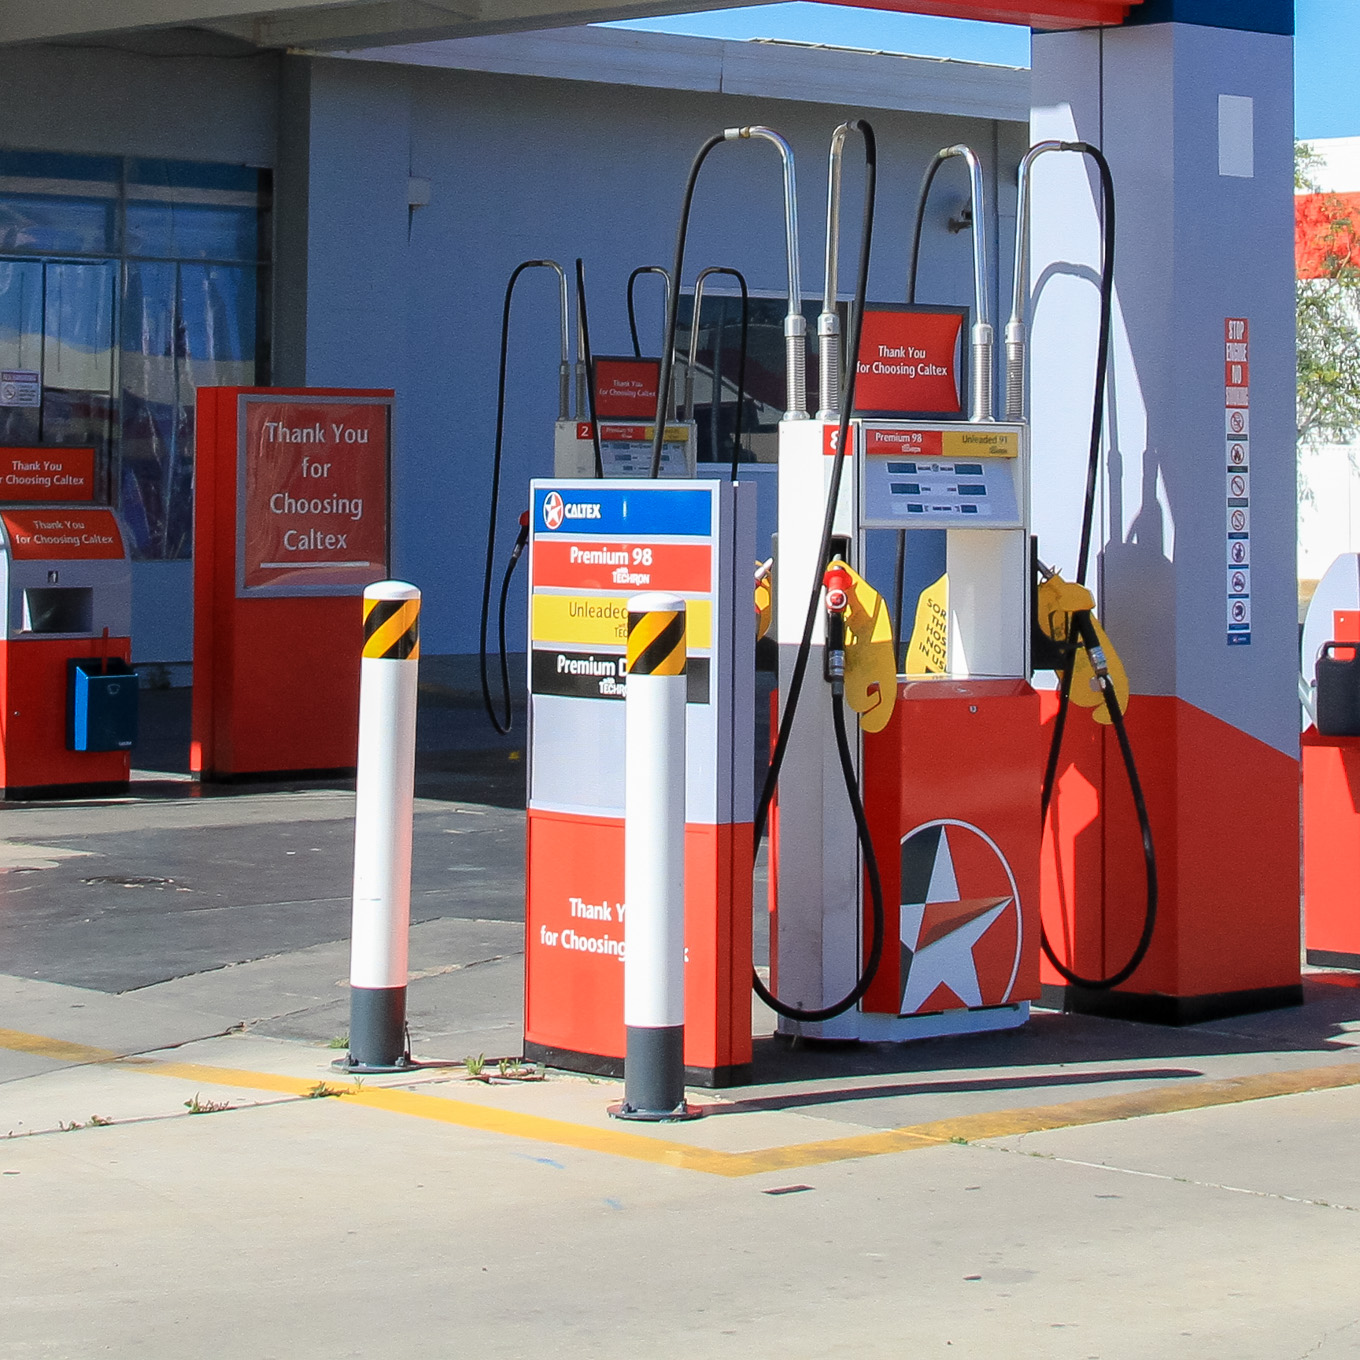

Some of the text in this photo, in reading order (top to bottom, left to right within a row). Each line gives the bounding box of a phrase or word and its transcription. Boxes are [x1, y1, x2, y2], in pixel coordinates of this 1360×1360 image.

[1228, 320, 1244, 340] STOP
[878, 345, 926, 359] Thank You
[856, 362, 947, 378] for Choosing Caltex
[266, 422, 368, 444] Thank You
[580, 425, 589, 437] 2
[875, 432, 922, 443] Premium 98
[962, 435, 997, 445] Unleaded
[11, 460, 62, 471] Thank You
[301, 457, 331, 478] for
[5, 474, 51, 487] Choosing
[53, 475, 84, 485] Caltex
[269, 492, 363, 521] Choosing
[564, 503, 601, 519] CALTEX
[33, 520, 85, 529] Thank You
[15, 534, 113, 546] for Choosing Caltex
[283, 528, 348, 550] Caltex
[570, 546, 653, 566] Premium 98
[612, 571, 650, 586] TECHRON
[927, 598, 947, 620] SOR
[932, 614, 947, 633] THI
[926, 624, 947, 646] HOS
[919, 641, 930, 657] IN
[557, 654, 616, 676] Premium
[598, 681, 627, 697] TECHR
[569, 897, 612, 921] Thank
[540, 925, 626, 962] for Choosing
